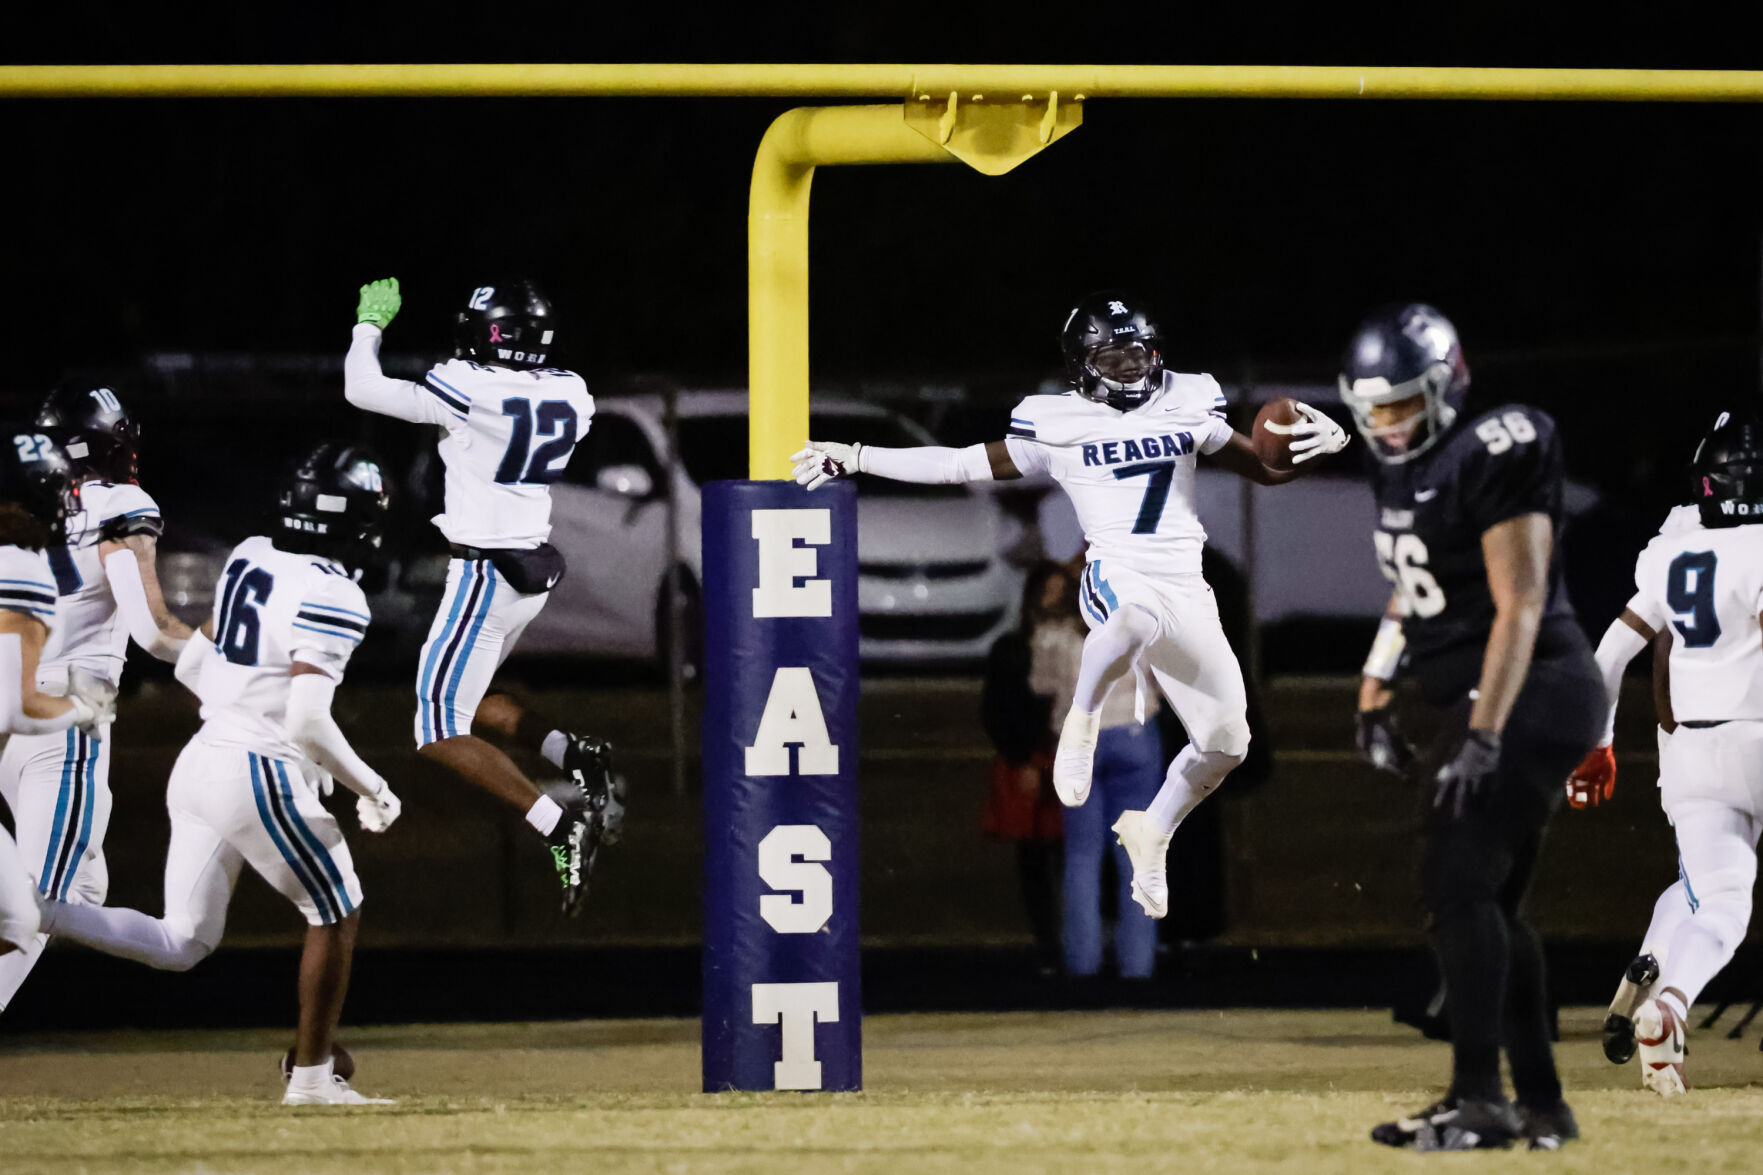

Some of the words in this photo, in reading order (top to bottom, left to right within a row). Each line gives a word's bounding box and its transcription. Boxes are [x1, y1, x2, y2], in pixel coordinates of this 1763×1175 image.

[468, 286, 495, 311] 12
[89, 388, 122, 414] 10
[1475, 411, 1537, 455] 56
[13, 434, 54, 462] 22
[492, 396, 578, 486] 12
[1081, 431, 1195, 467] REAGAN
[1112, 460, 1176, 535] 7
[214, 558, 274, 666] 16
[1373, 530, 1447, 619] 56
[1666, 549, 1722, 649] 9
[744, 508, 840, 1091] EAST
